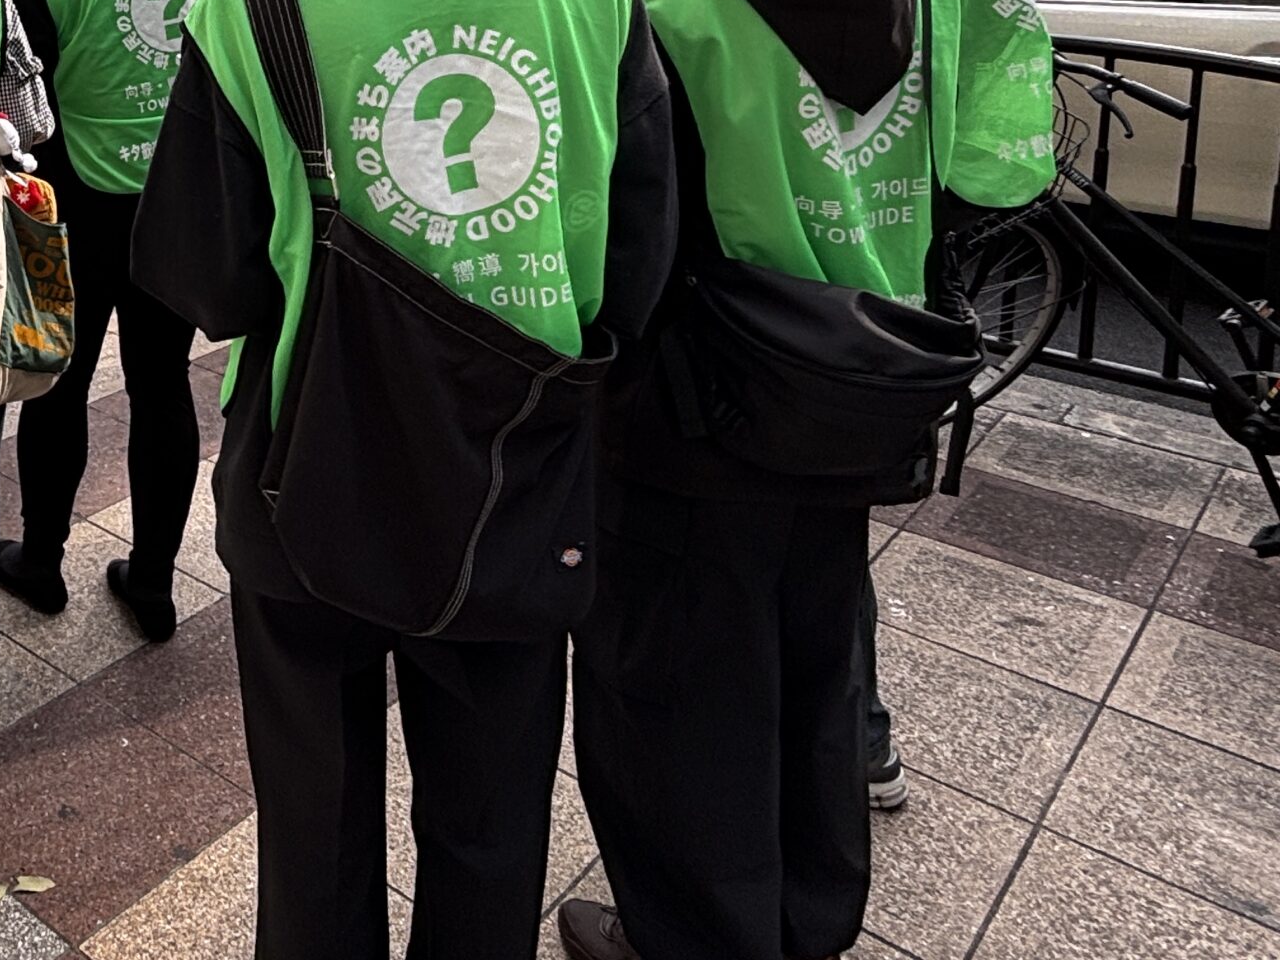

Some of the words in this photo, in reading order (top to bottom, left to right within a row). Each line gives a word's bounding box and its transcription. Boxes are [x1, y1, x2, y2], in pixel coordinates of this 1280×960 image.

[349, 28, 459, 248] 地元民のまち案内
[871, 177, 930, 200] 가이드
[490, 282, 572, 308] GUIDE
